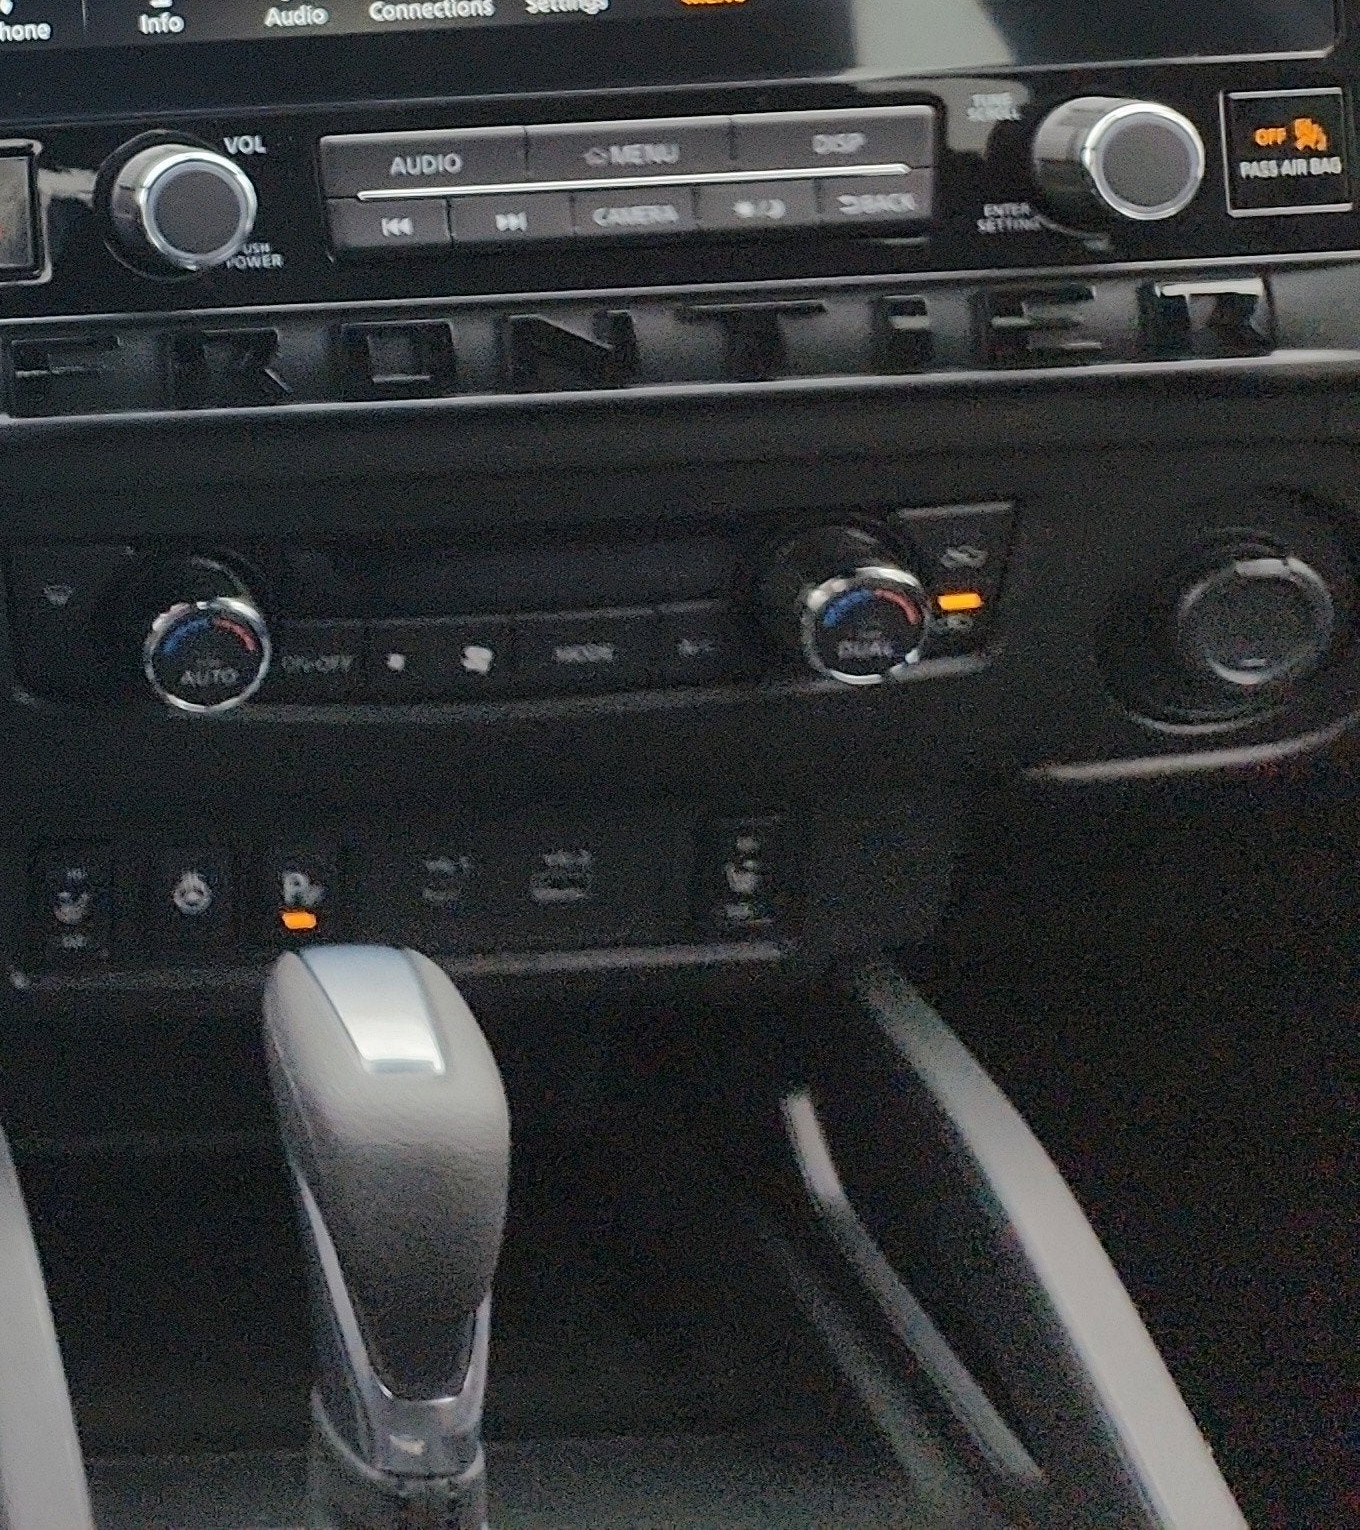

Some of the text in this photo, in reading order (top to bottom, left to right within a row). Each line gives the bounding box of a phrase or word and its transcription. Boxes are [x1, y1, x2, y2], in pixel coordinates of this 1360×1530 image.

[140, 11, 184, 34] Info
[265, 4, 328, 27] Audio
[224, 135, 266, 155] VOL
[1255, 127, 1287, 146] OFF
[391, 153, 462, 176] AUDIO
[610, 144, 679, 165] MENU
[1240, 160, 1278, 179] PASS
[1281, 158, 1307, 176] AIR
[181, 669, 237, 688] AUTO
